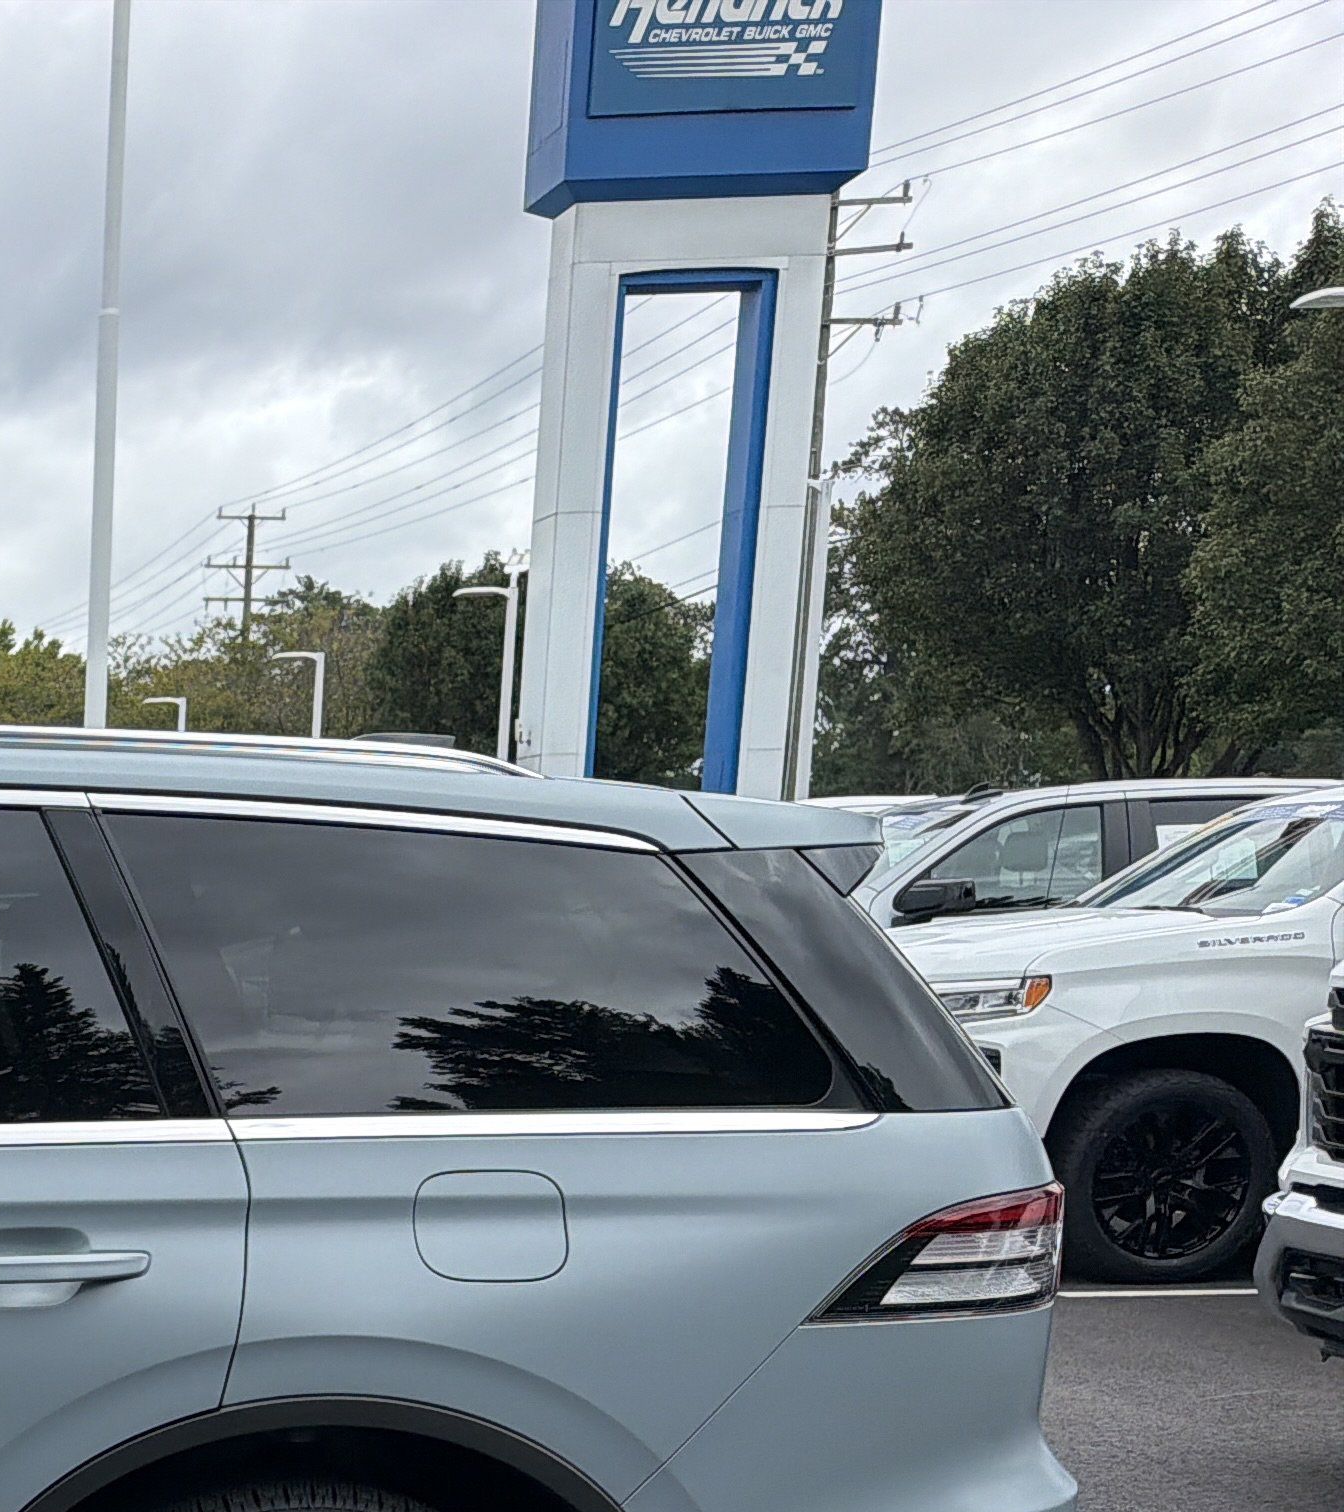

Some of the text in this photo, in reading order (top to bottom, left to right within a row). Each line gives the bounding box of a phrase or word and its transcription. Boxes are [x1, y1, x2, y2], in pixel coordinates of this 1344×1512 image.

[648, 23, 834, 43] CHEVROLET BUICK GMC
[1197, 931, 1305, 948] SILVERADO
